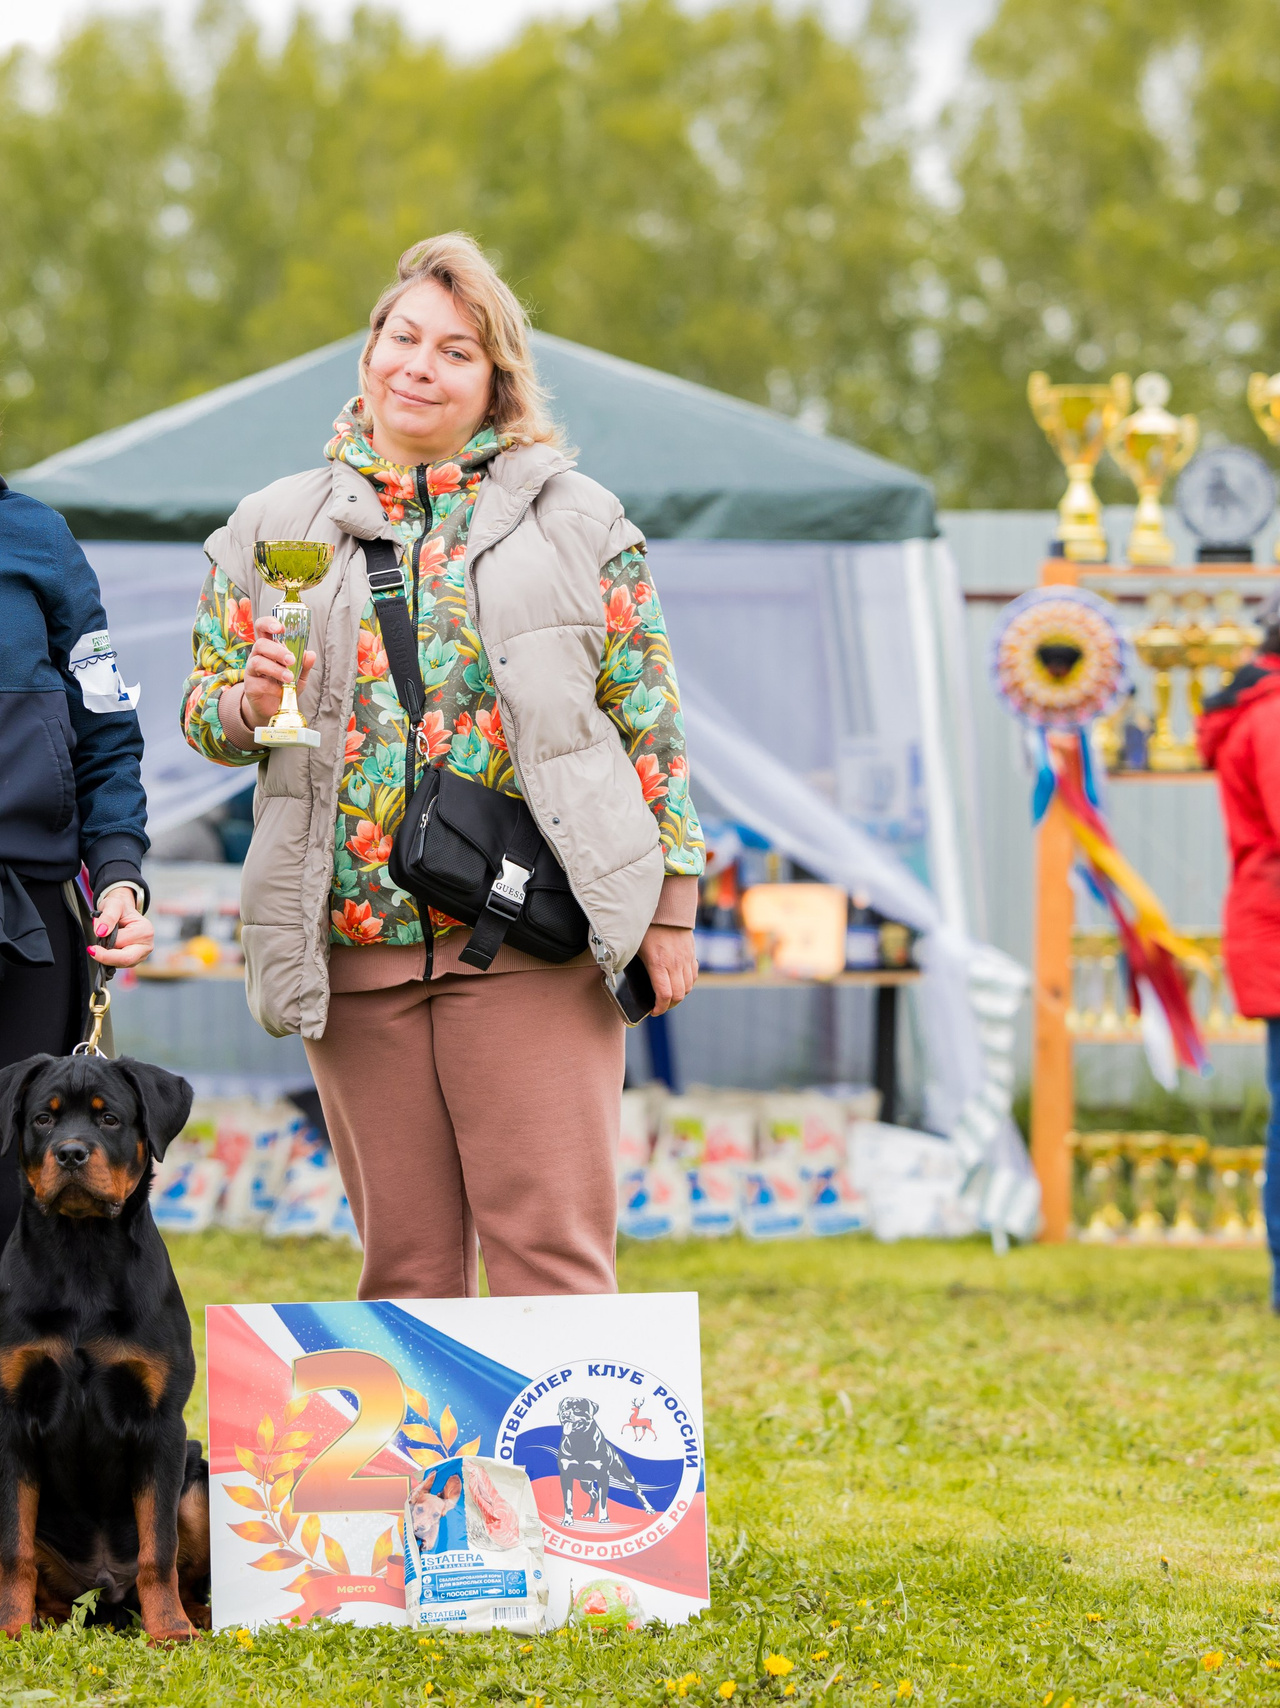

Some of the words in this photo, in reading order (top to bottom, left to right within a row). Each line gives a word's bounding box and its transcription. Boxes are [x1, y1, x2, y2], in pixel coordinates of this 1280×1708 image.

[495, 881, 525, 901] GUESS
[588, 1364, 645, 1386] КЛУБ
[652, 1385, 699, 1468] РОССИИ
[290, 1348, 411, 1514] 2
[672, 1499, 688, 1523] РО
[426, 1553, 484, 1566] STATERA
[336, 1585, 377, 1594] место
[446, 1589, 479, 1598] ЛОСОСЕМ
[427, 1609, 467, 1618] STATERA
